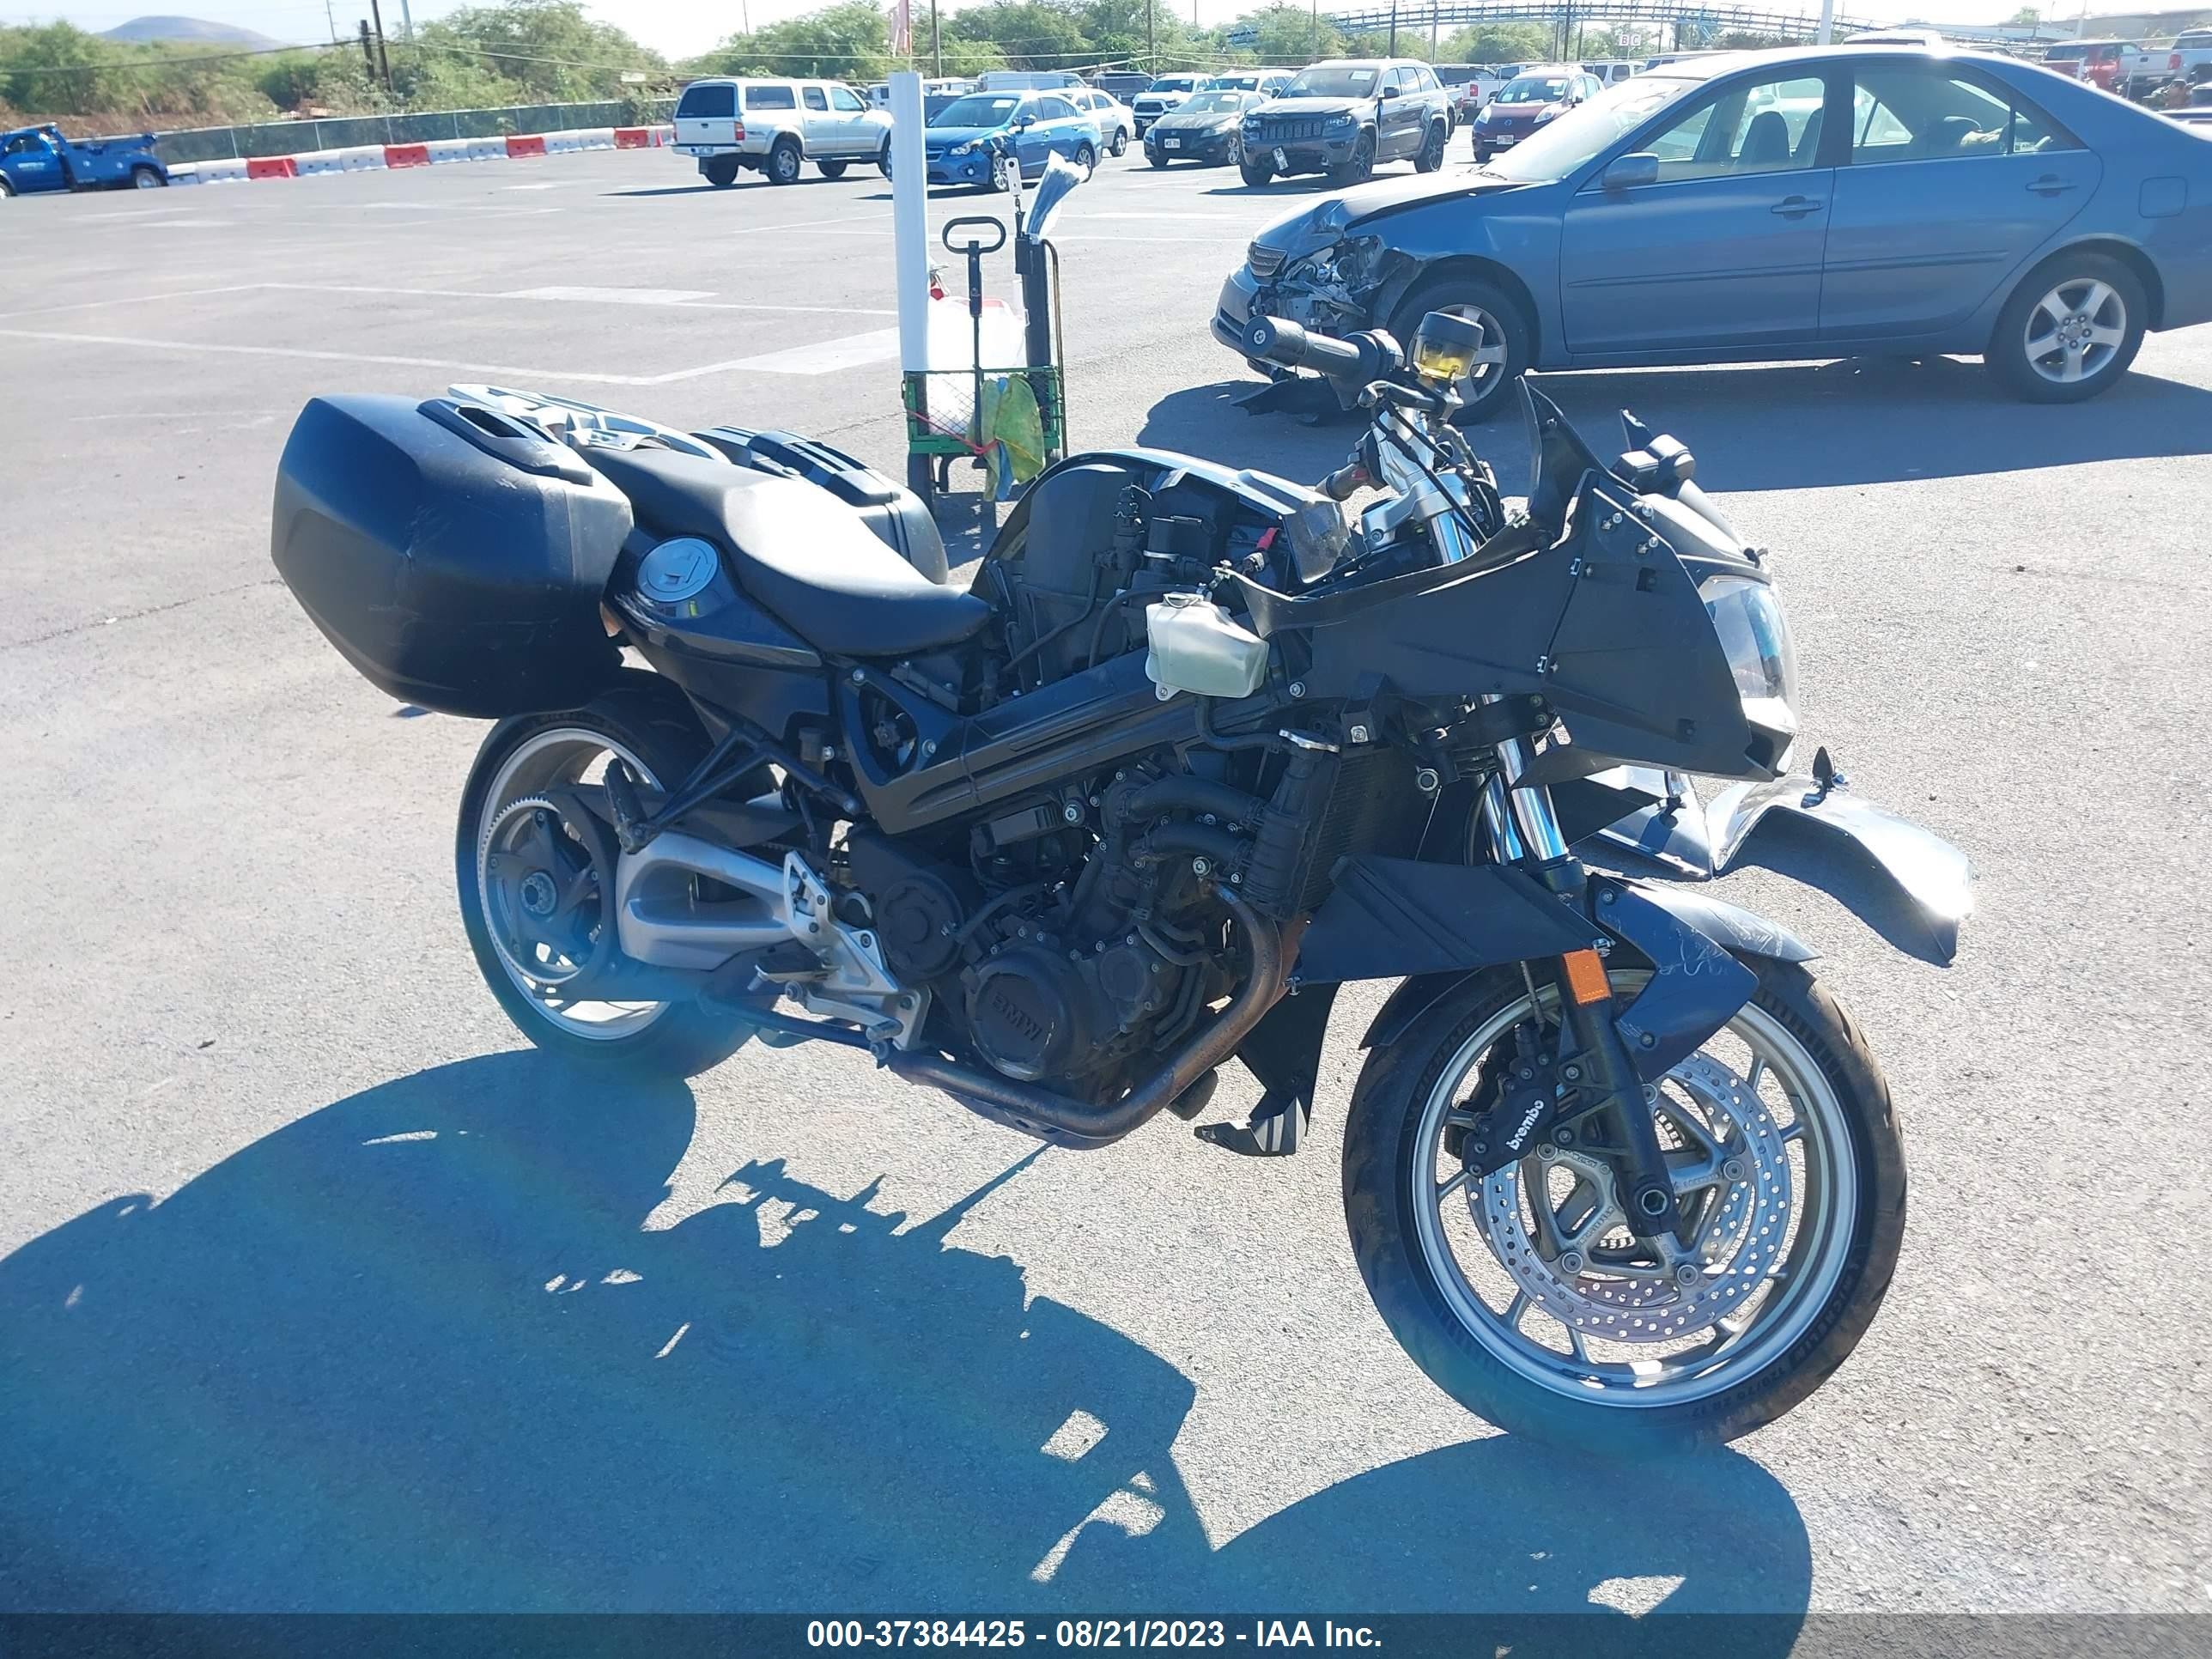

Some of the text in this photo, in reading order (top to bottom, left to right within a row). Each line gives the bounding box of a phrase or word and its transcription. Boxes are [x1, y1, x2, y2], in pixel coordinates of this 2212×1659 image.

[1621, 35, 1639, 45] B C
[993, 991, 1042, 1041] BMW
[1505, 1099, 1545, 1151] brembo
